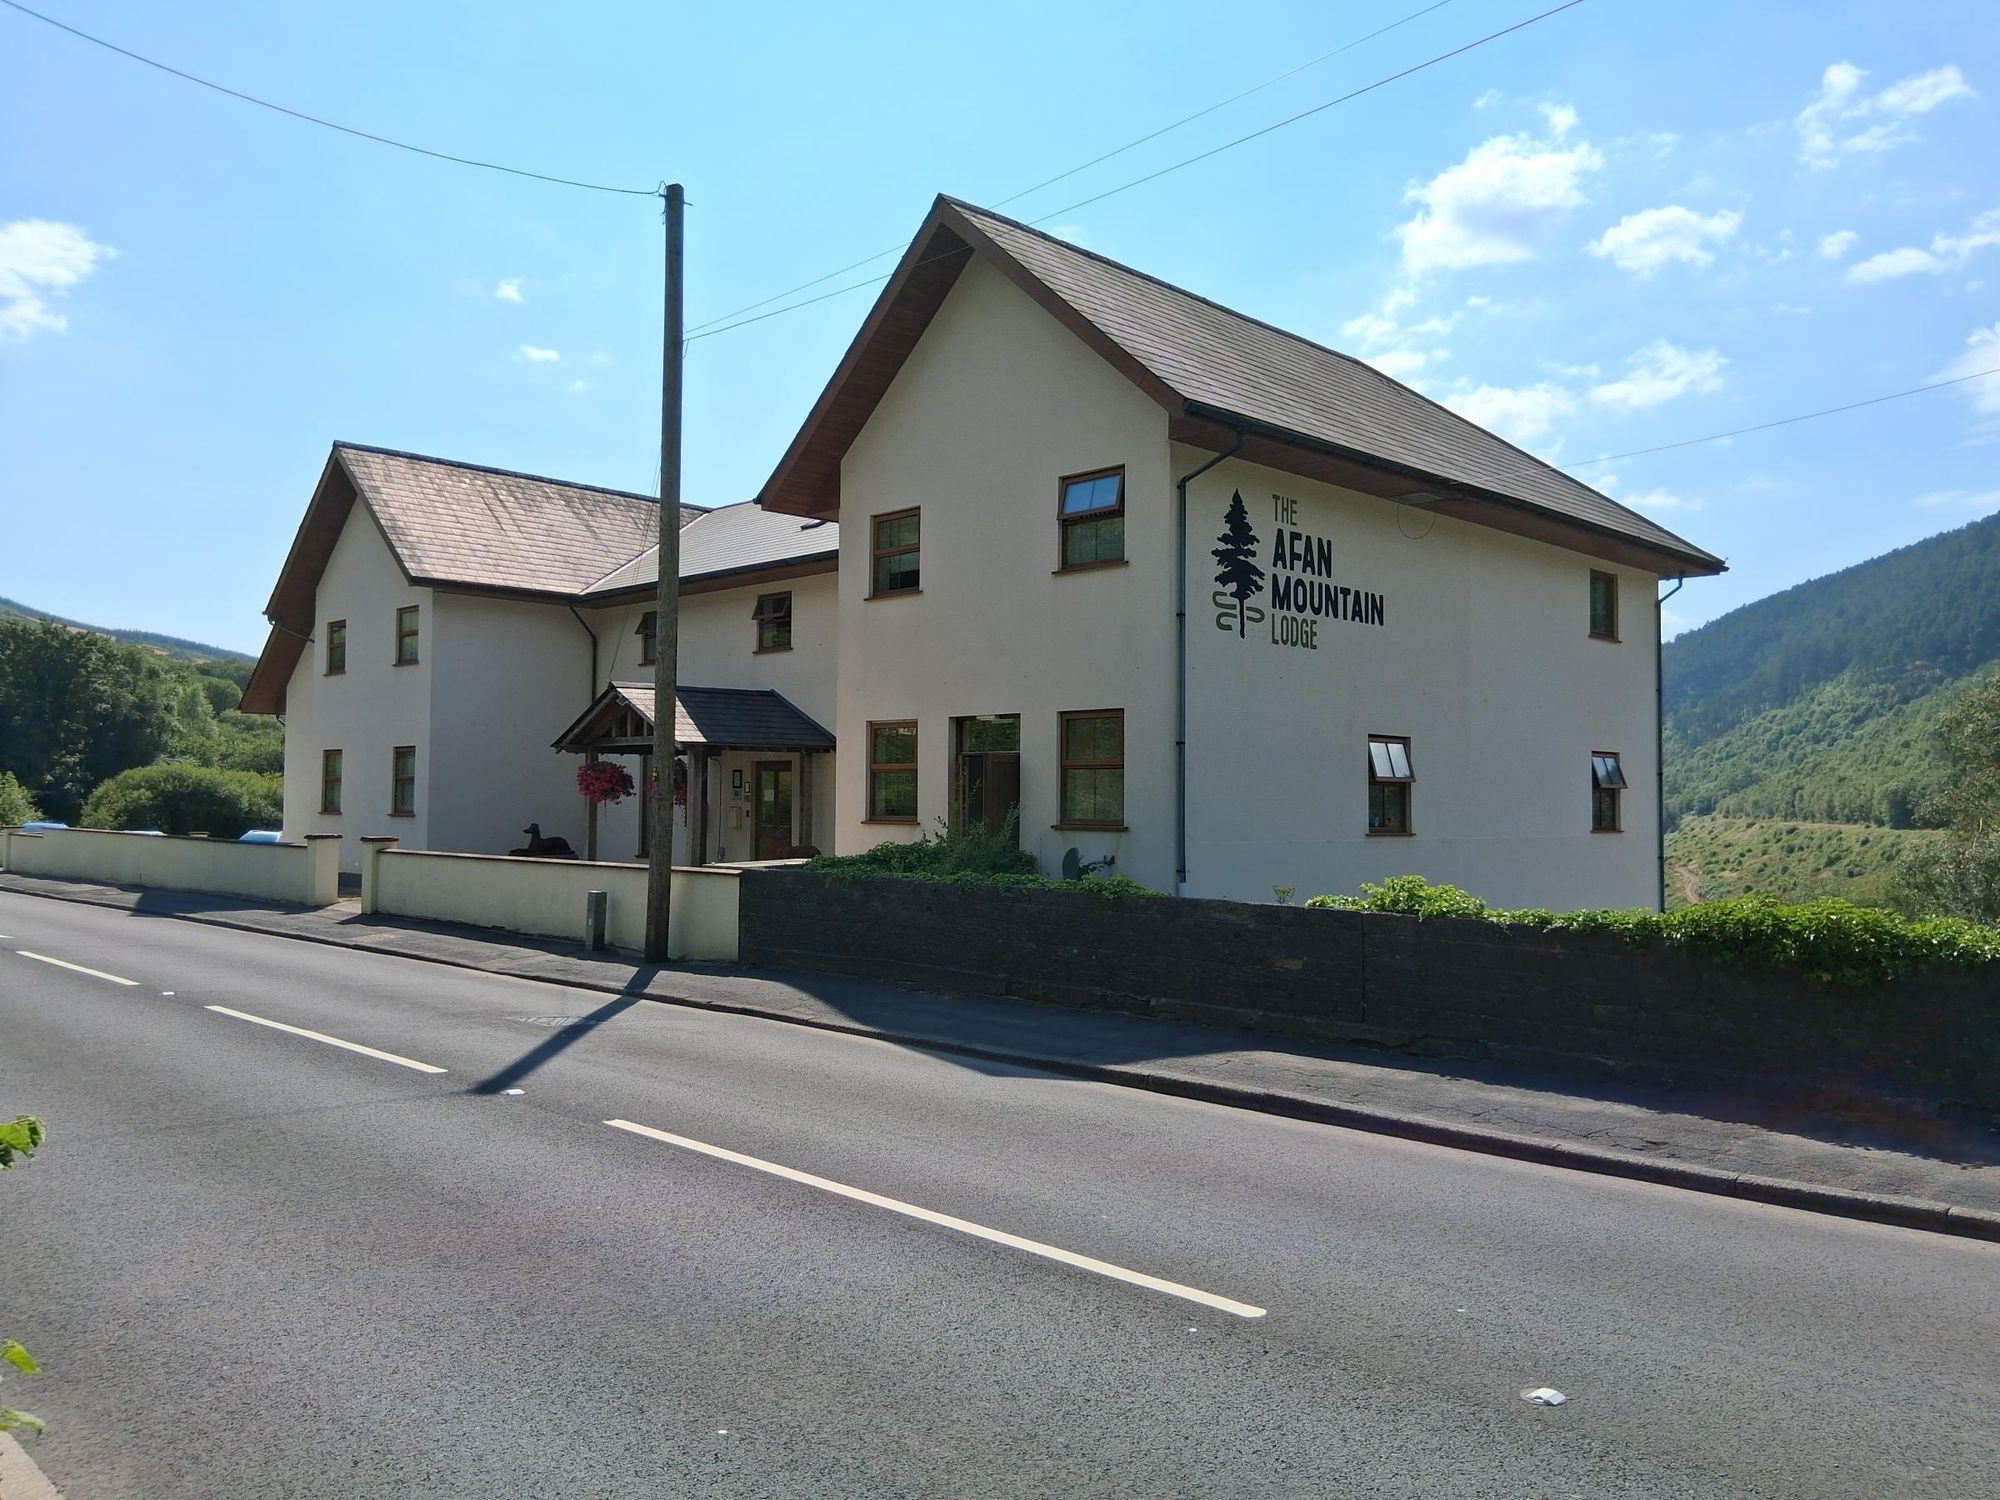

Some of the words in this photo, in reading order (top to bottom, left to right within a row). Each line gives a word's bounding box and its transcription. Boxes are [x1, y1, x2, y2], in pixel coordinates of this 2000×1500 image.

[1272, 494, 1298, 526] THE
[1272, 528, 1332, 578] AFAN
[1271, 573, 1384, 627] MOUNTAIN
[1271, 613, 1317, 650] LODGE
